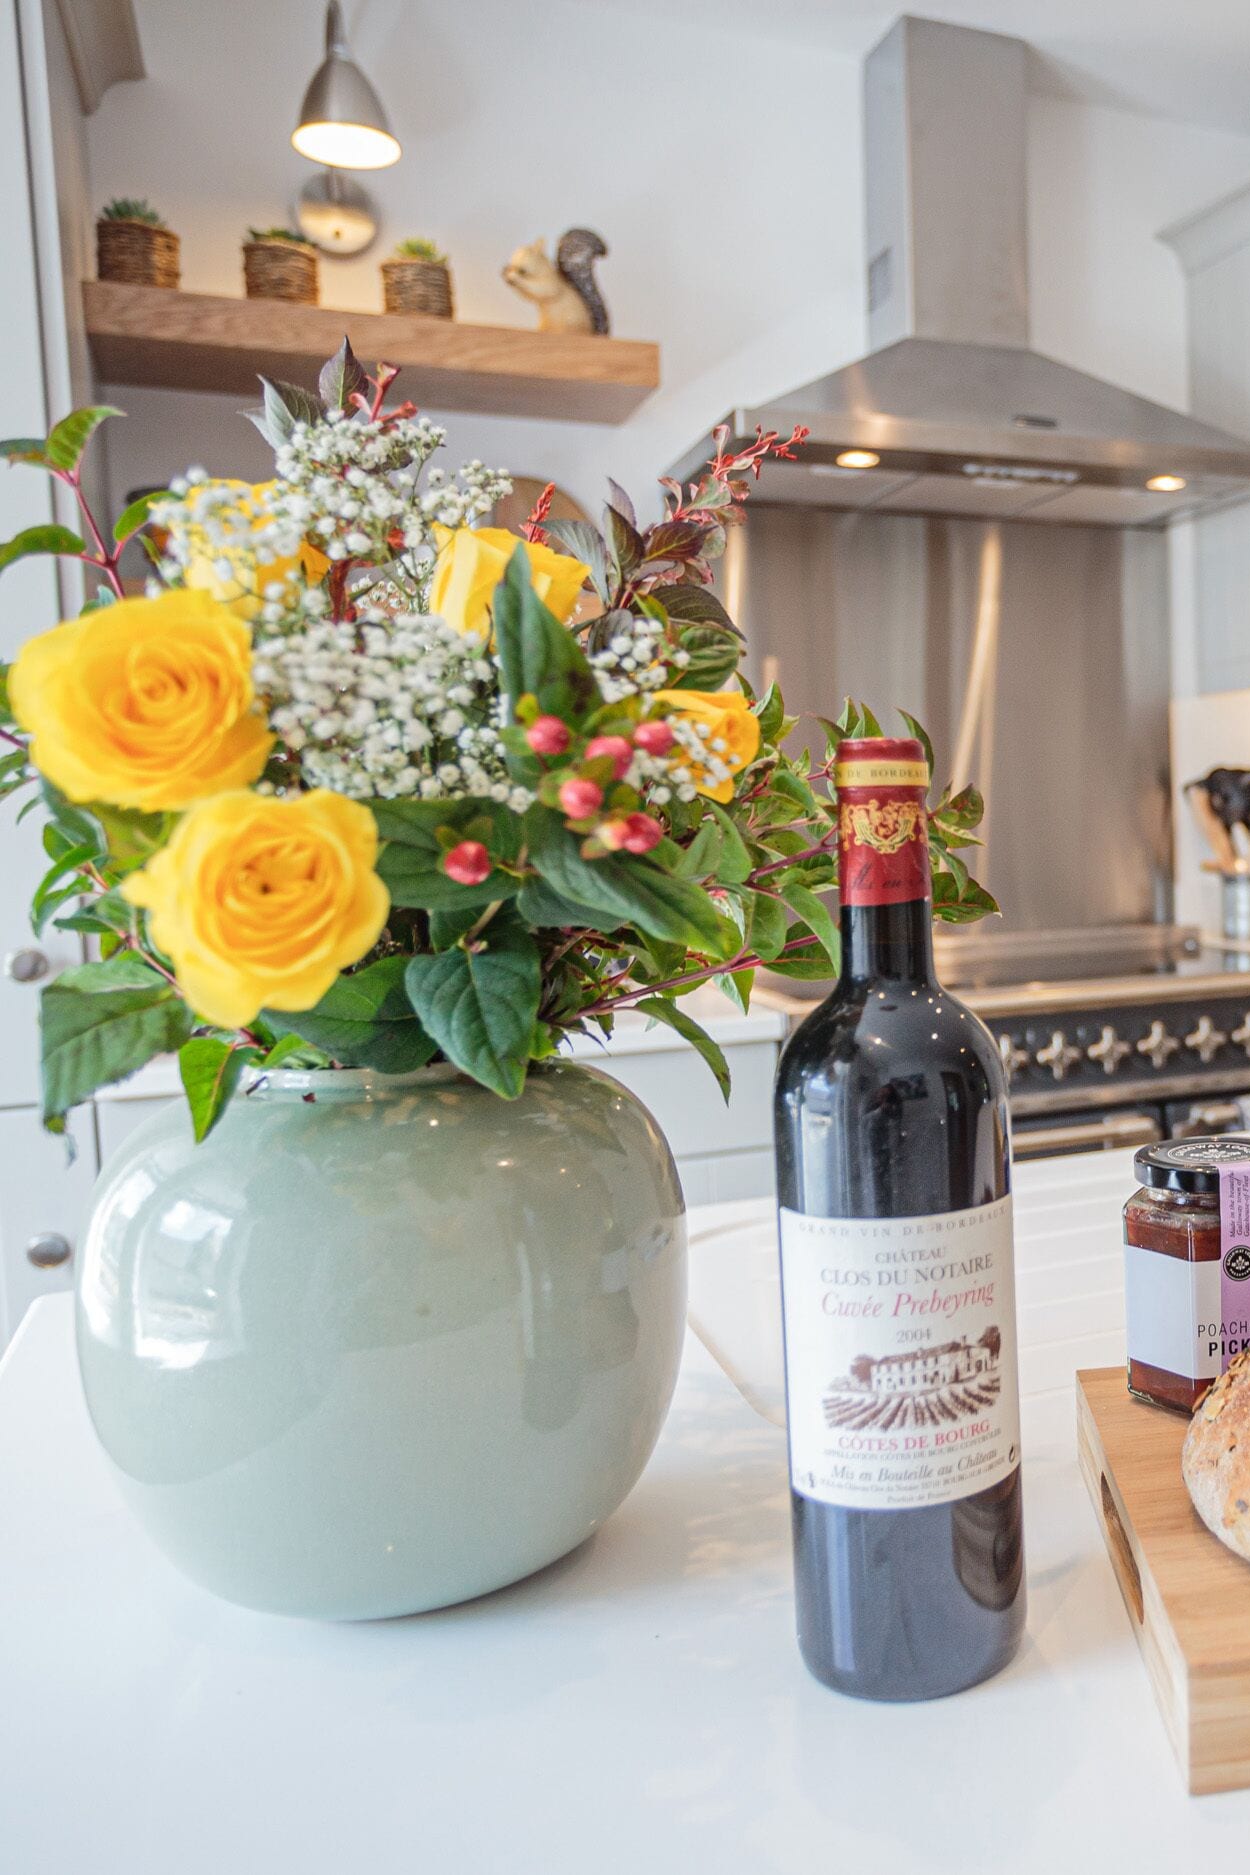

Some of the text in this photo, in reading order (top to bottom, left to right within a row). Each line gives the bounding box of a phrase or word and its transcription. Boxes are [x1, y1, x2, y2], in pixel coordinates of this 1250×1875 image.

[870, 767, 928, 778] BORDEAU
[860, 1227, 891, 1238] VIN
[934, 1206, 1008, 1233] BORDEAUX
[820, 1252, 993, 1287] CLOS DU NOTAIRE
[821, 1292, 882, 1318] Cuvée
[896, 1328, 932, 1344] 2004
[837, 1421, 990, 1452] CÔTES DE BOURG
[831, 1464, 855, 1480] Mis
[859, 1471, 873, 1481] en
[937, 1465, 953, 1476] au
[957, 1448, 998, 1472] Château
